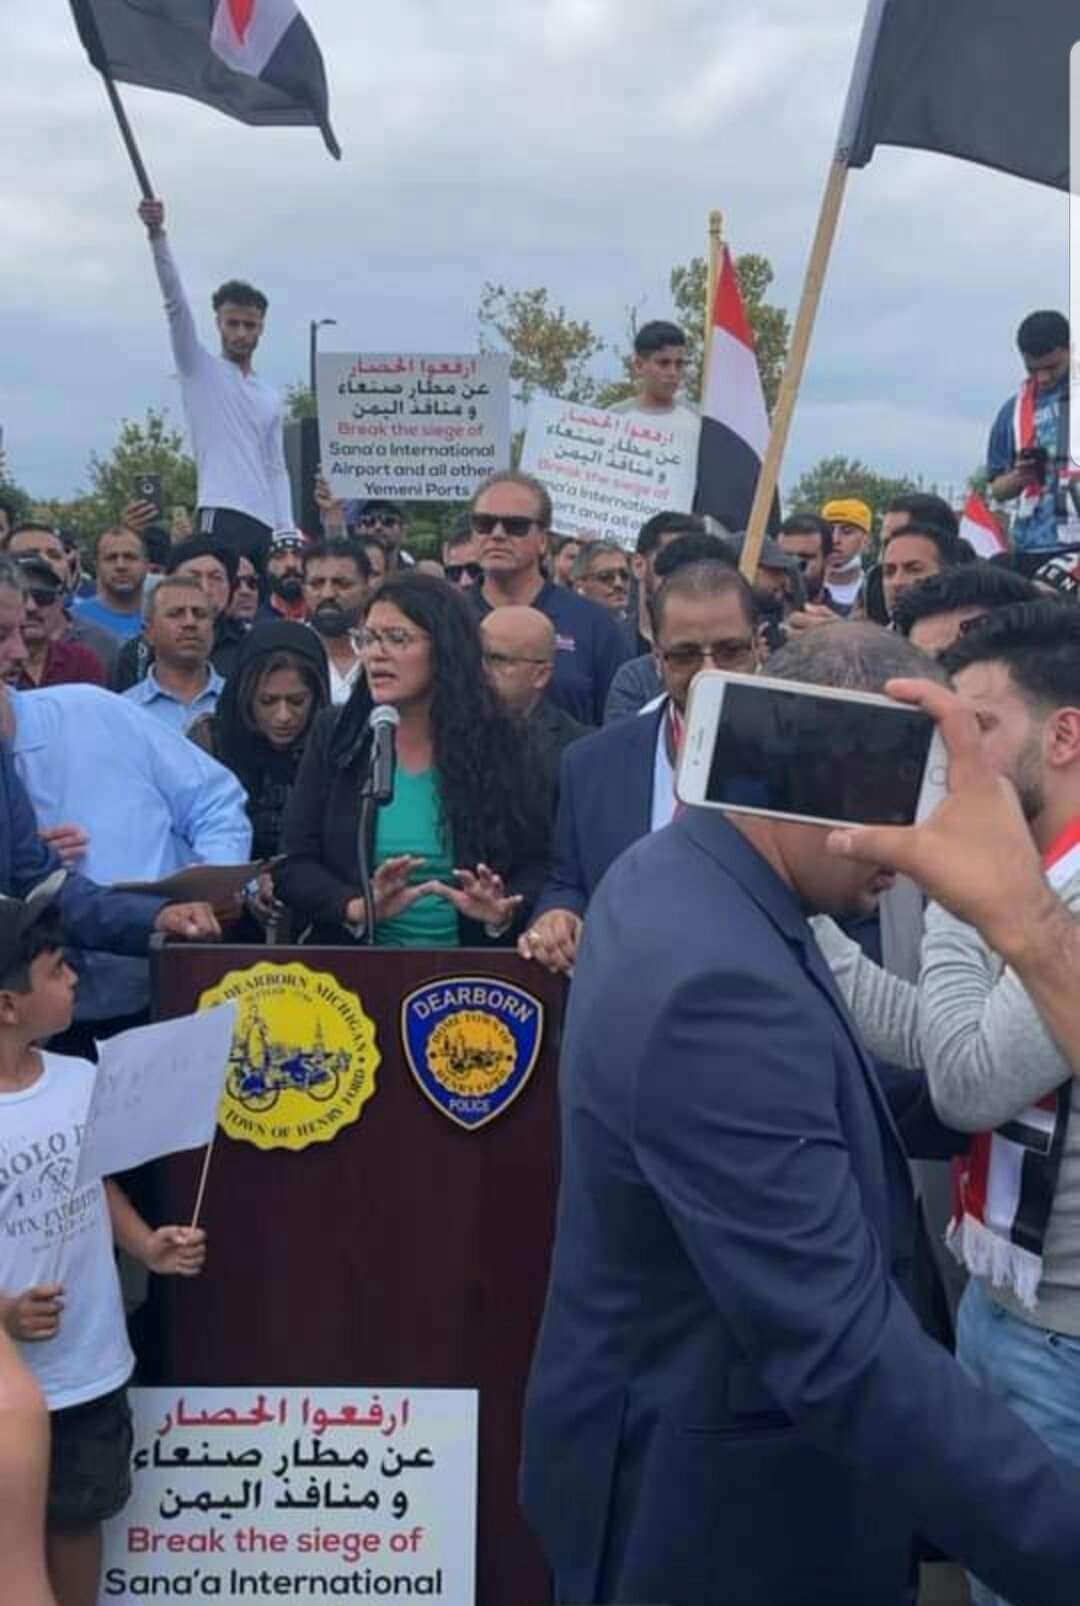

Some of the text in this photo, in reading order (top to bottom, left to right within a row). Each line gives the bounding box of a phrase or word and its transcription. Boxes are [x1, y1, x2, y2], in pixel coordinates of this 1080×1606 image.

[350, 356, 477, 378] ارفعوا الحصار
[338, 380, 489, 398] عن مطار صنعاء
[352, 399, 477, 420] و منافذ اليمن
[337, 422, 482, 441] Break the siege of
[329, 442, 495, 456] Sana'a International
[331, 462, 494, 478] Airport and all other
[365, 483, 470, 497] Yemeni Ports
[316, 982, 368, 1052] MICHIGAN
[412, 987, 534, 1023] DEARBORN
[225, 1069, 366, 1138] TOWN OF HENRY FORD
[449, 1098, 490, 1112] POLICE
[159, 1394, 409, 1435] ارفعوا الحصار
[133, 1438, 435, 1477] عن مطار صنعاء
[159, 1476, 408, 1519] و منافذ اليمن
[128, 1527, 424, 1562] Break the siege of
[105, 1568, 442, 1596] Sana'a International
